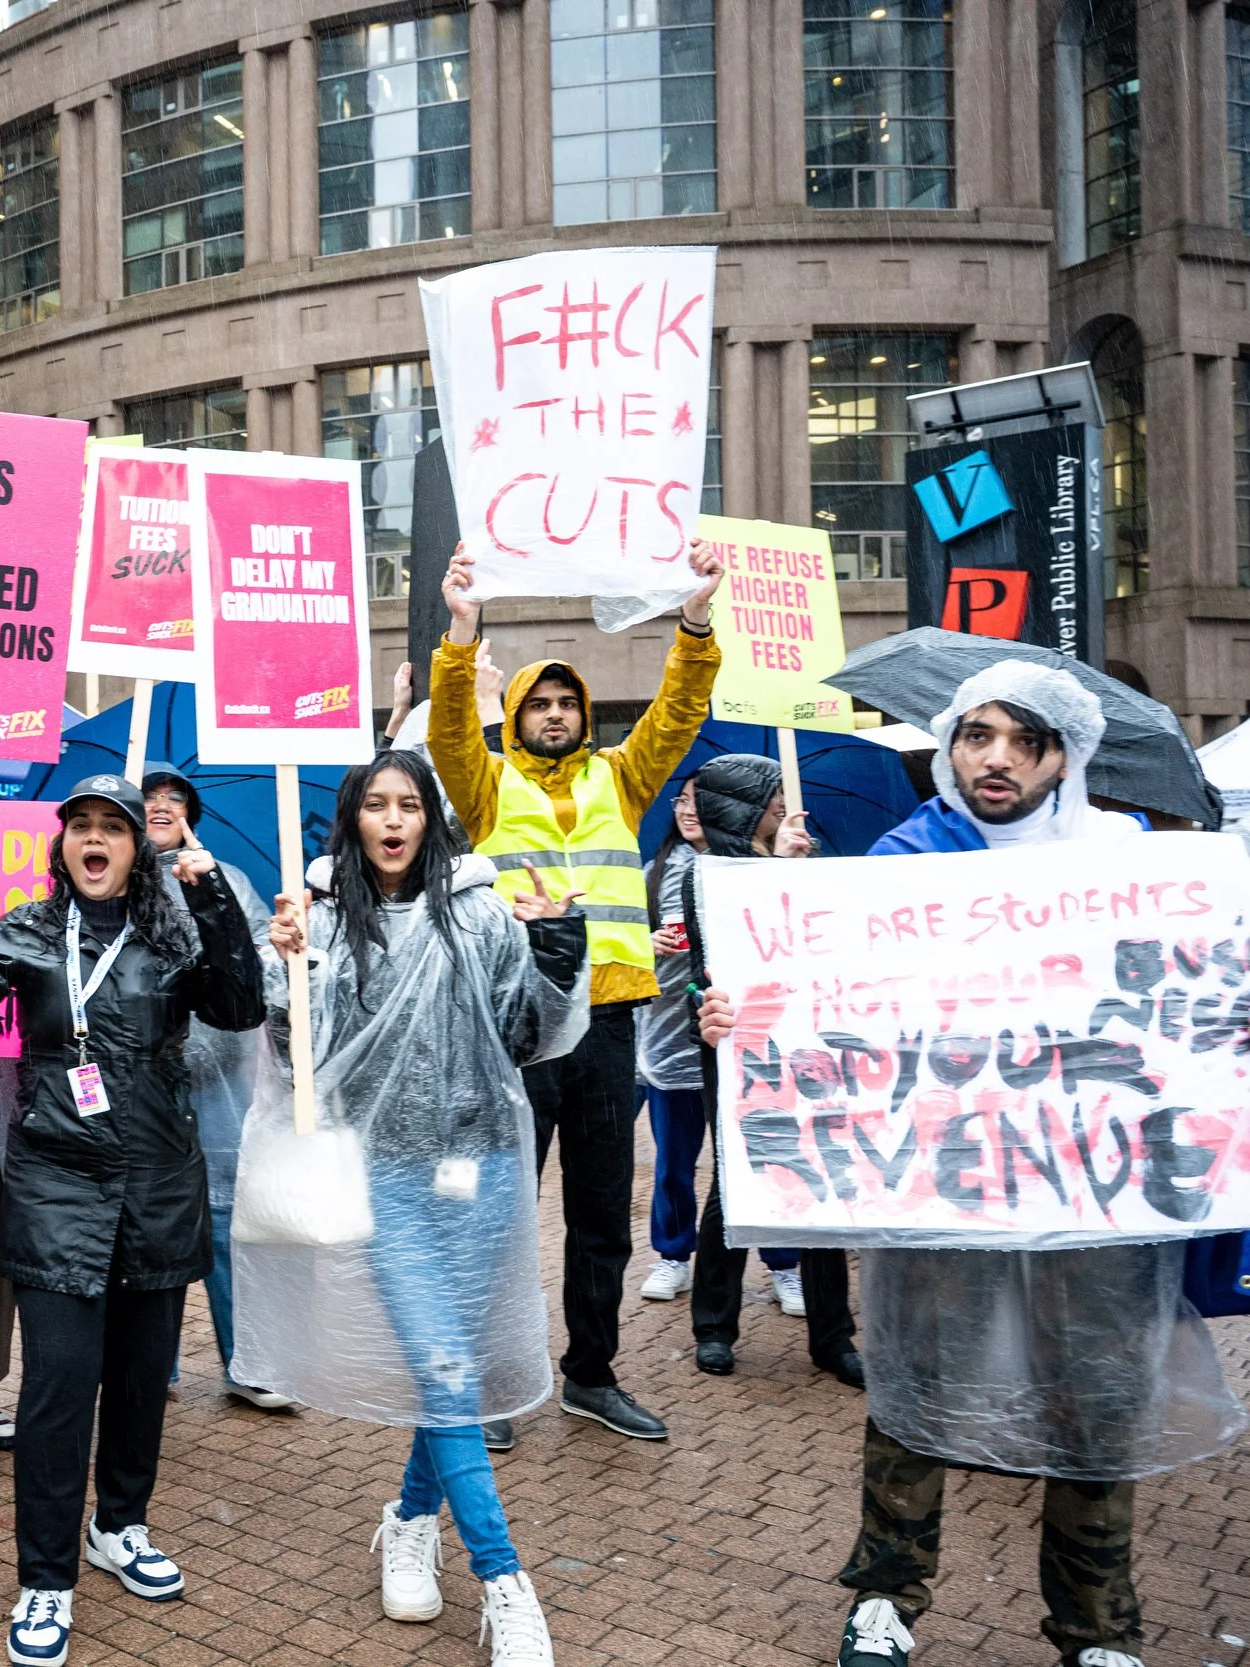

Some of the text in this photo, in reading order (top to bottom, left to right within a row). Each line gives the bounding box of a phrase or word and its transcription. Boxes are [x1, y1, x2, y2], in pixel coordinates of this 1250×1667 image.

[490, 277, 706, 392] F#CK
[512, 391, 658, 440] THE
[933, 462, 990, 527] V
[1049, 455, 1080, 536] Library
[485, 471, 692, 563] CUTS
[128, 525, 178, 553] FEES
[250, 524, 313, 556] DON'T
[111, 548, 191, 580] SUCK
[230, 557, 336, 590] DELAY MY
[746, 546, 826, 581] REFUSE
[1050, 540, 1076, 612] Public
[220, 590, 350, 625] GRADUATION
[730, 574, 809, 610] HIGHER
[948, 577, 1007, 634] P
[730, 606, 814, 642] TUITION
[751, 640, 803, 672] FEES
[742, 891, 834, 964] WE
[868, 903, 946, 952] ARE
